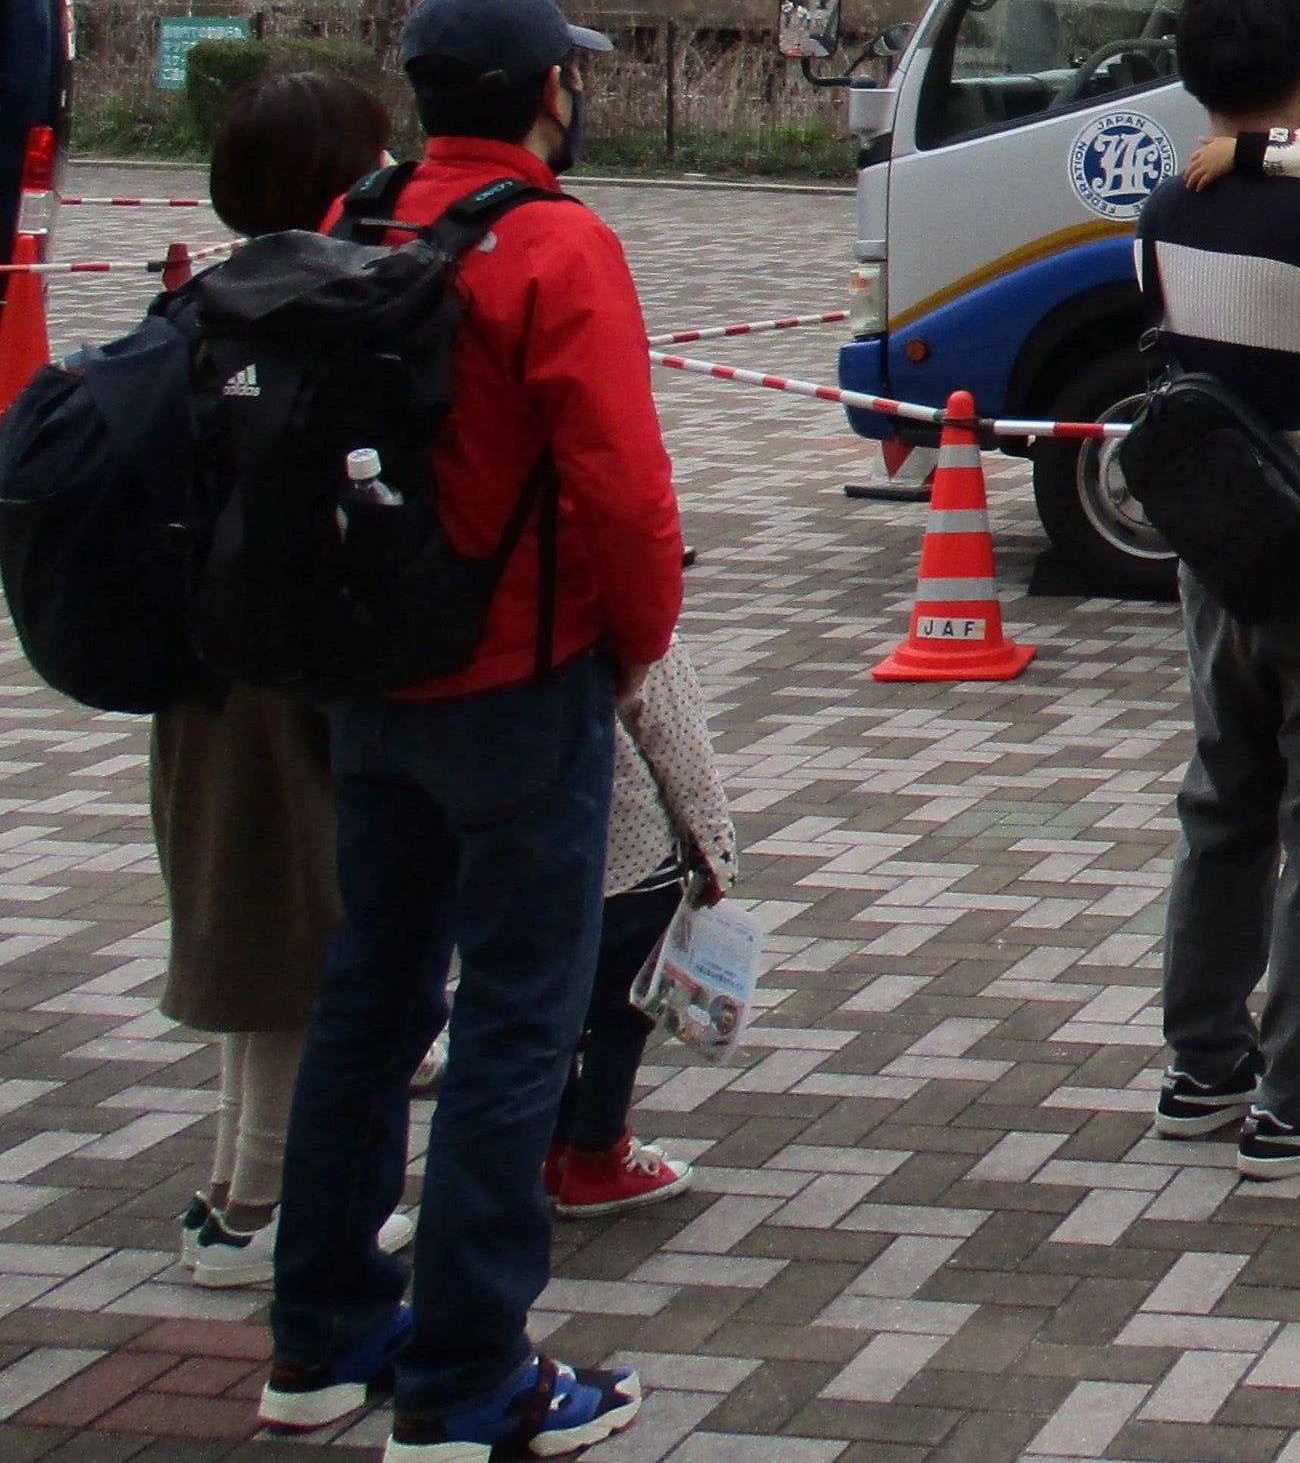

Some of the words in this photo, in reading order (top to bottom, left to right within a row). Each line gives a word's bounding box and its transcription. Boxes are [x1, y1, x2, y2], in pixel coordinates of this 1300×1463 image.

[1097, 116, 1146, 130] JAPAN
[1074, 141, 1117, 214] FEDERATION
[222, 385, 261, 396] adidas
[924, 620, 975, 636] JAF
